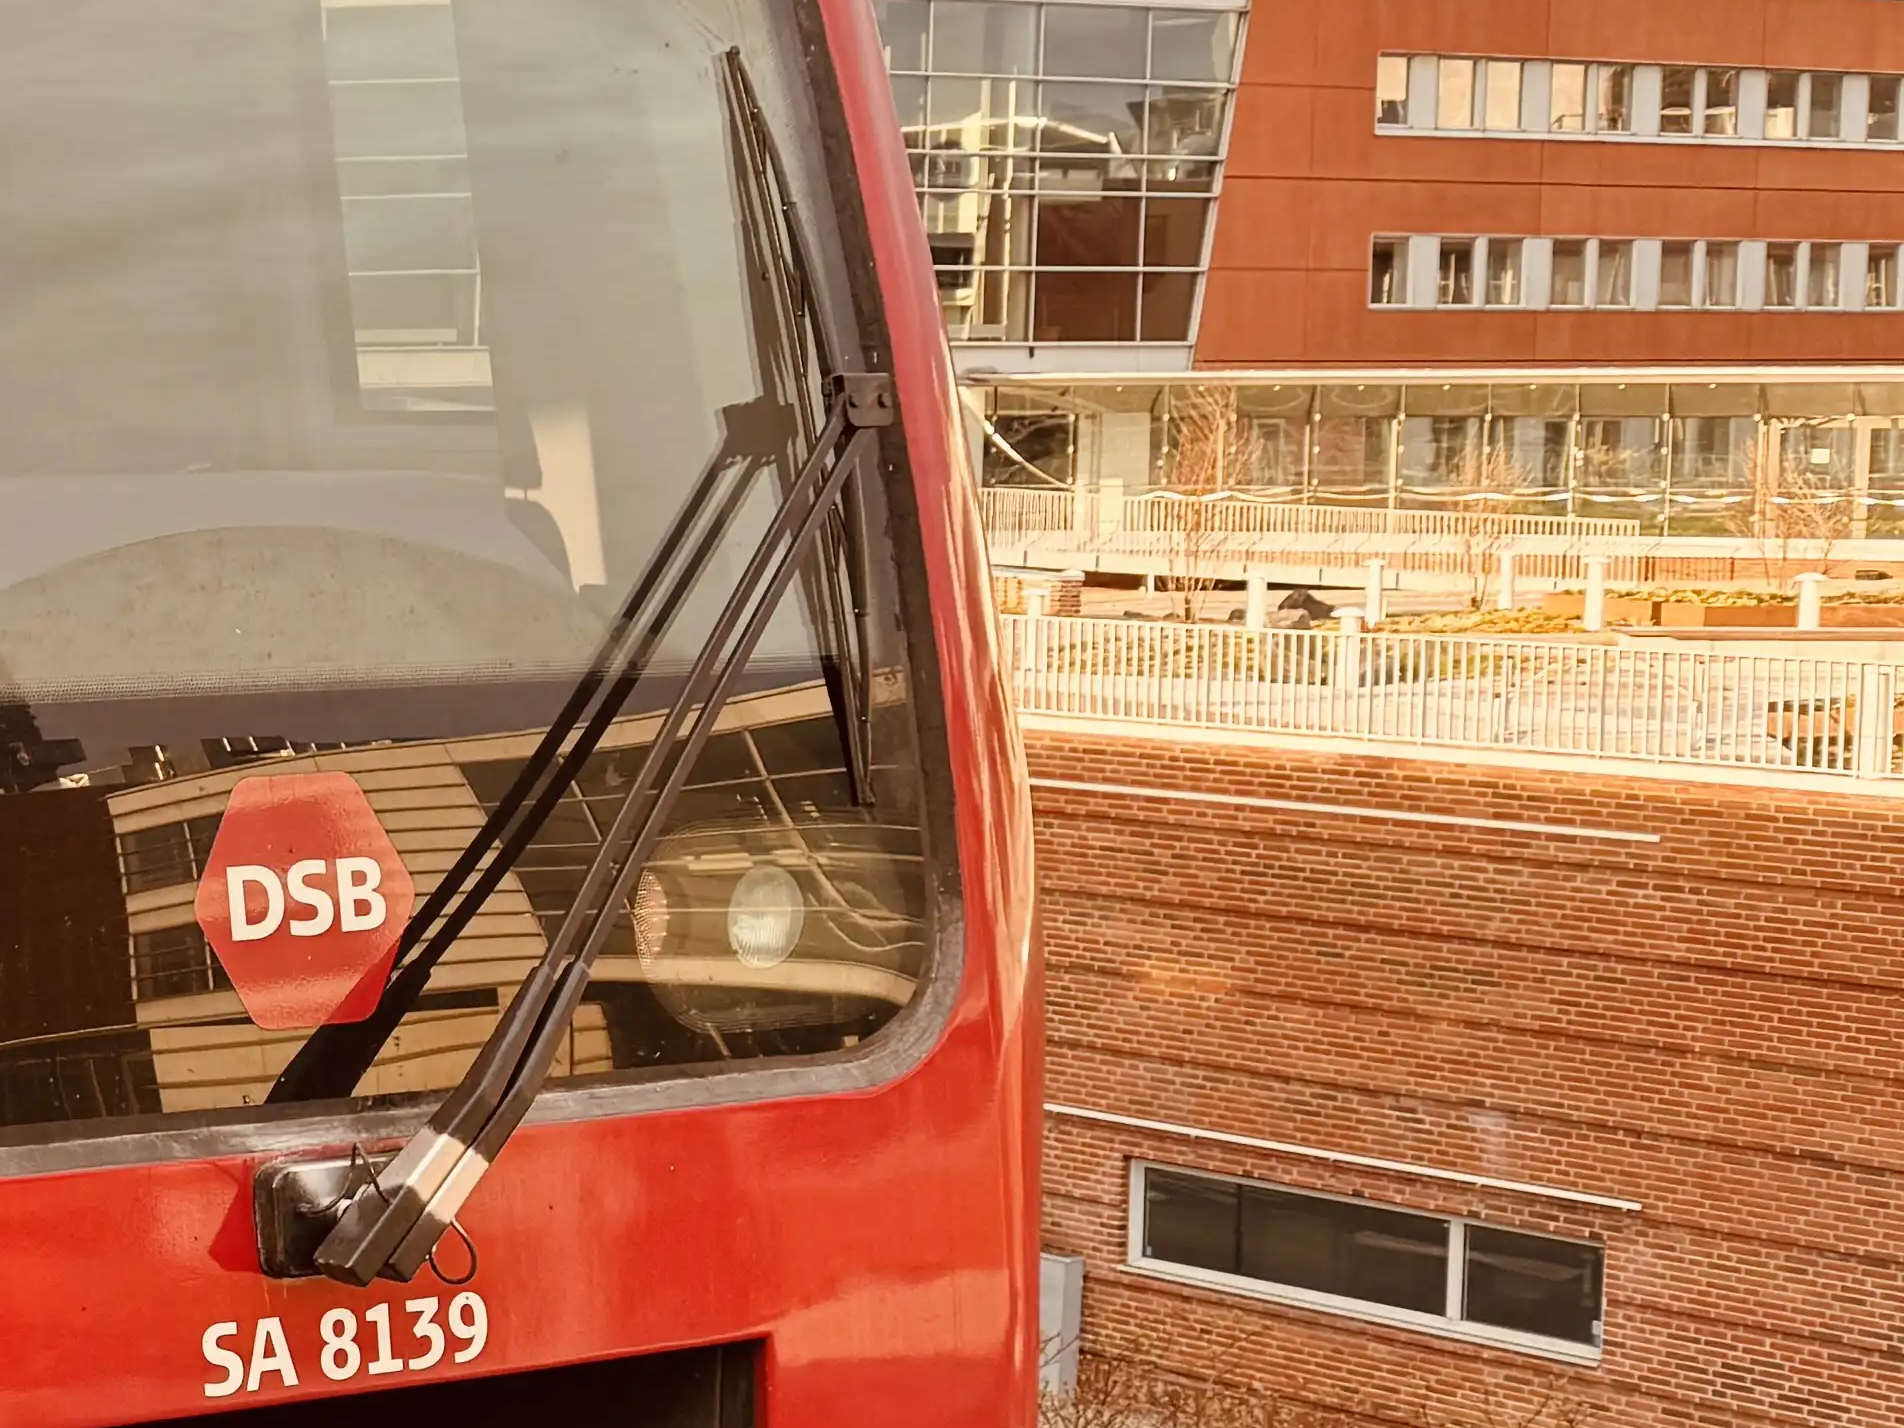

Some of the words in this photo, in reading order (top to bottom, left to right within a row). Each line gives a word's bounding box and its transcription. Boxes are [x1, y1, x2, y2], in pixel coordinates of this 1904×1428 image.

[226, 856, 387, 942] DSB
[201, 1316, 299, 1397] SA
[319, 1291, 488, 1381] 8139
